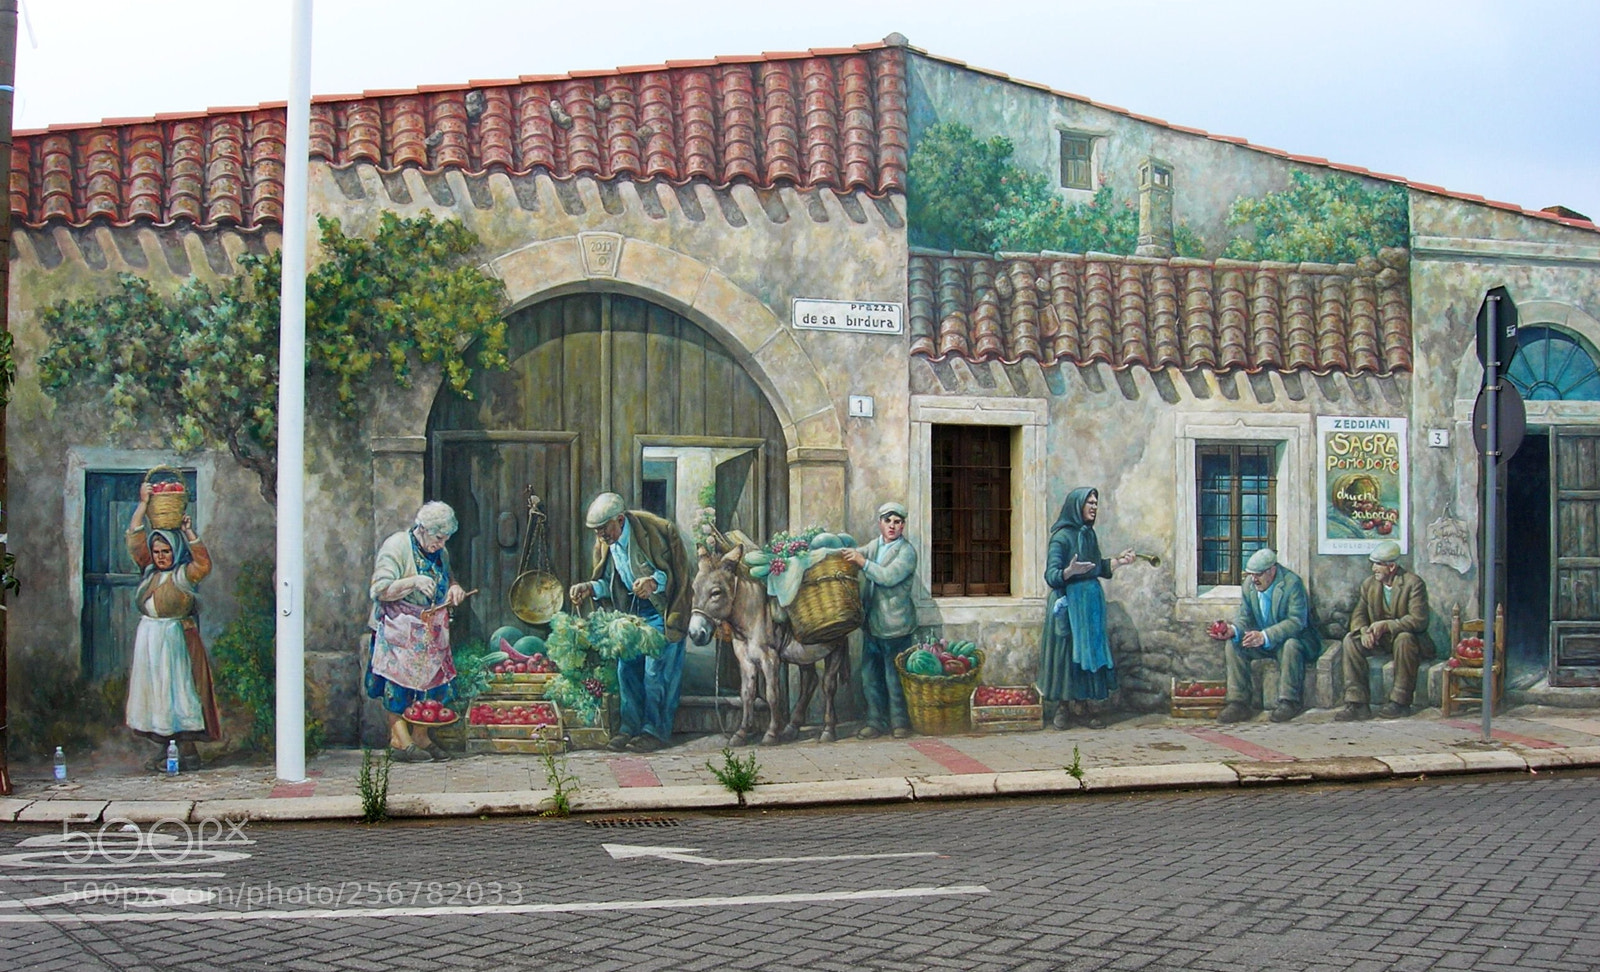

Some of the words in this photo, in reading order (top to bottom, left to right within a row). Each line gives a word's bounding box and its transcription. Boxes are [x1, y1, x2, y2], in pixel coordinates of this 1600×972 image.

[802, 313, 818, 325] de
[822, 315, 836, 325] sa
[1334, 419, 1390, 430] ZEDDIANI
[1329, 433, 1398, 457] SAGRA
[1327, 456, 1399, 474] POMODORO
